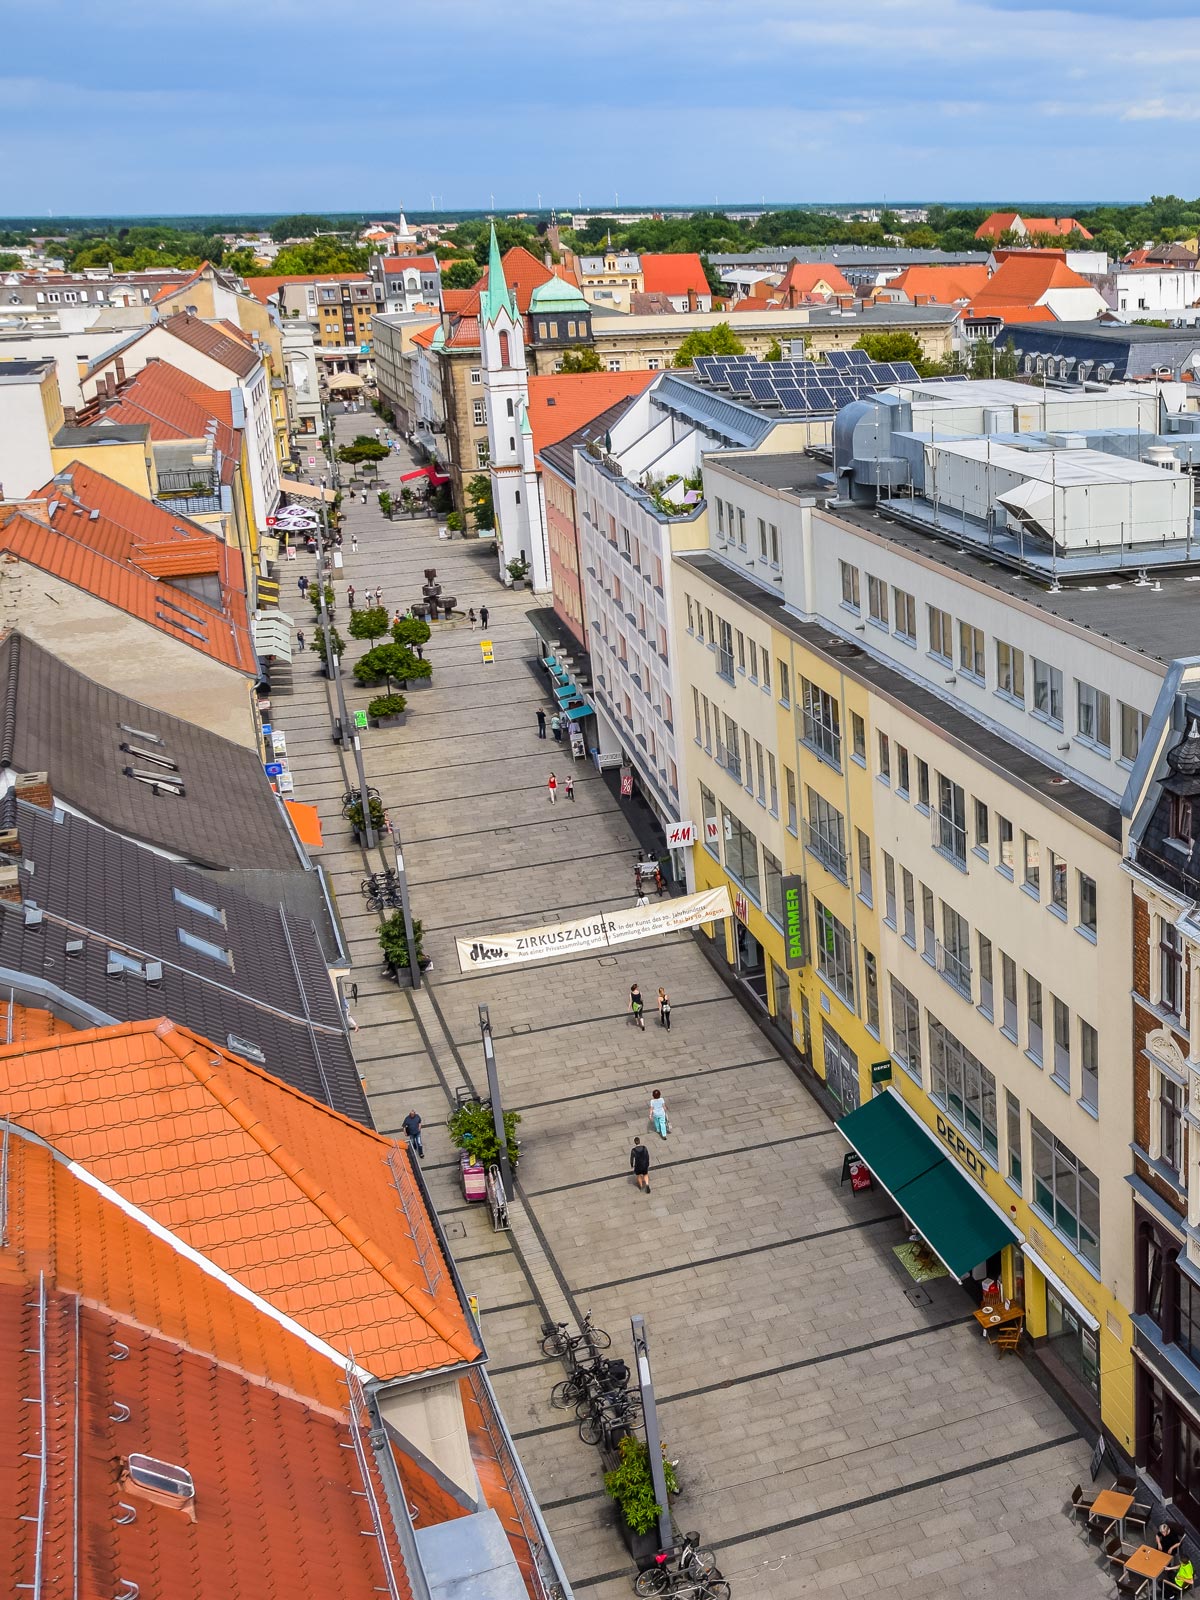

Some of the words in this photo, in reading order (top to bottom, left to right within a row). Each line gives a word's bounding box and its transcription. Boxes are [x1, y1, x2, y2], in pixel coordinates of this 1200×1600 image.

[669, 827, 691, 843] H&M
[705, 907, 725, 917] August
[635, 918, 651, 926] Kunst
[786, 888, 803, 959] BARMER
[516, 921, 617, 949] ZIRKUSZAUBER
[469, 943, 509, 962] dkw.
[936, 1114, 987, 1181] DEPOT
